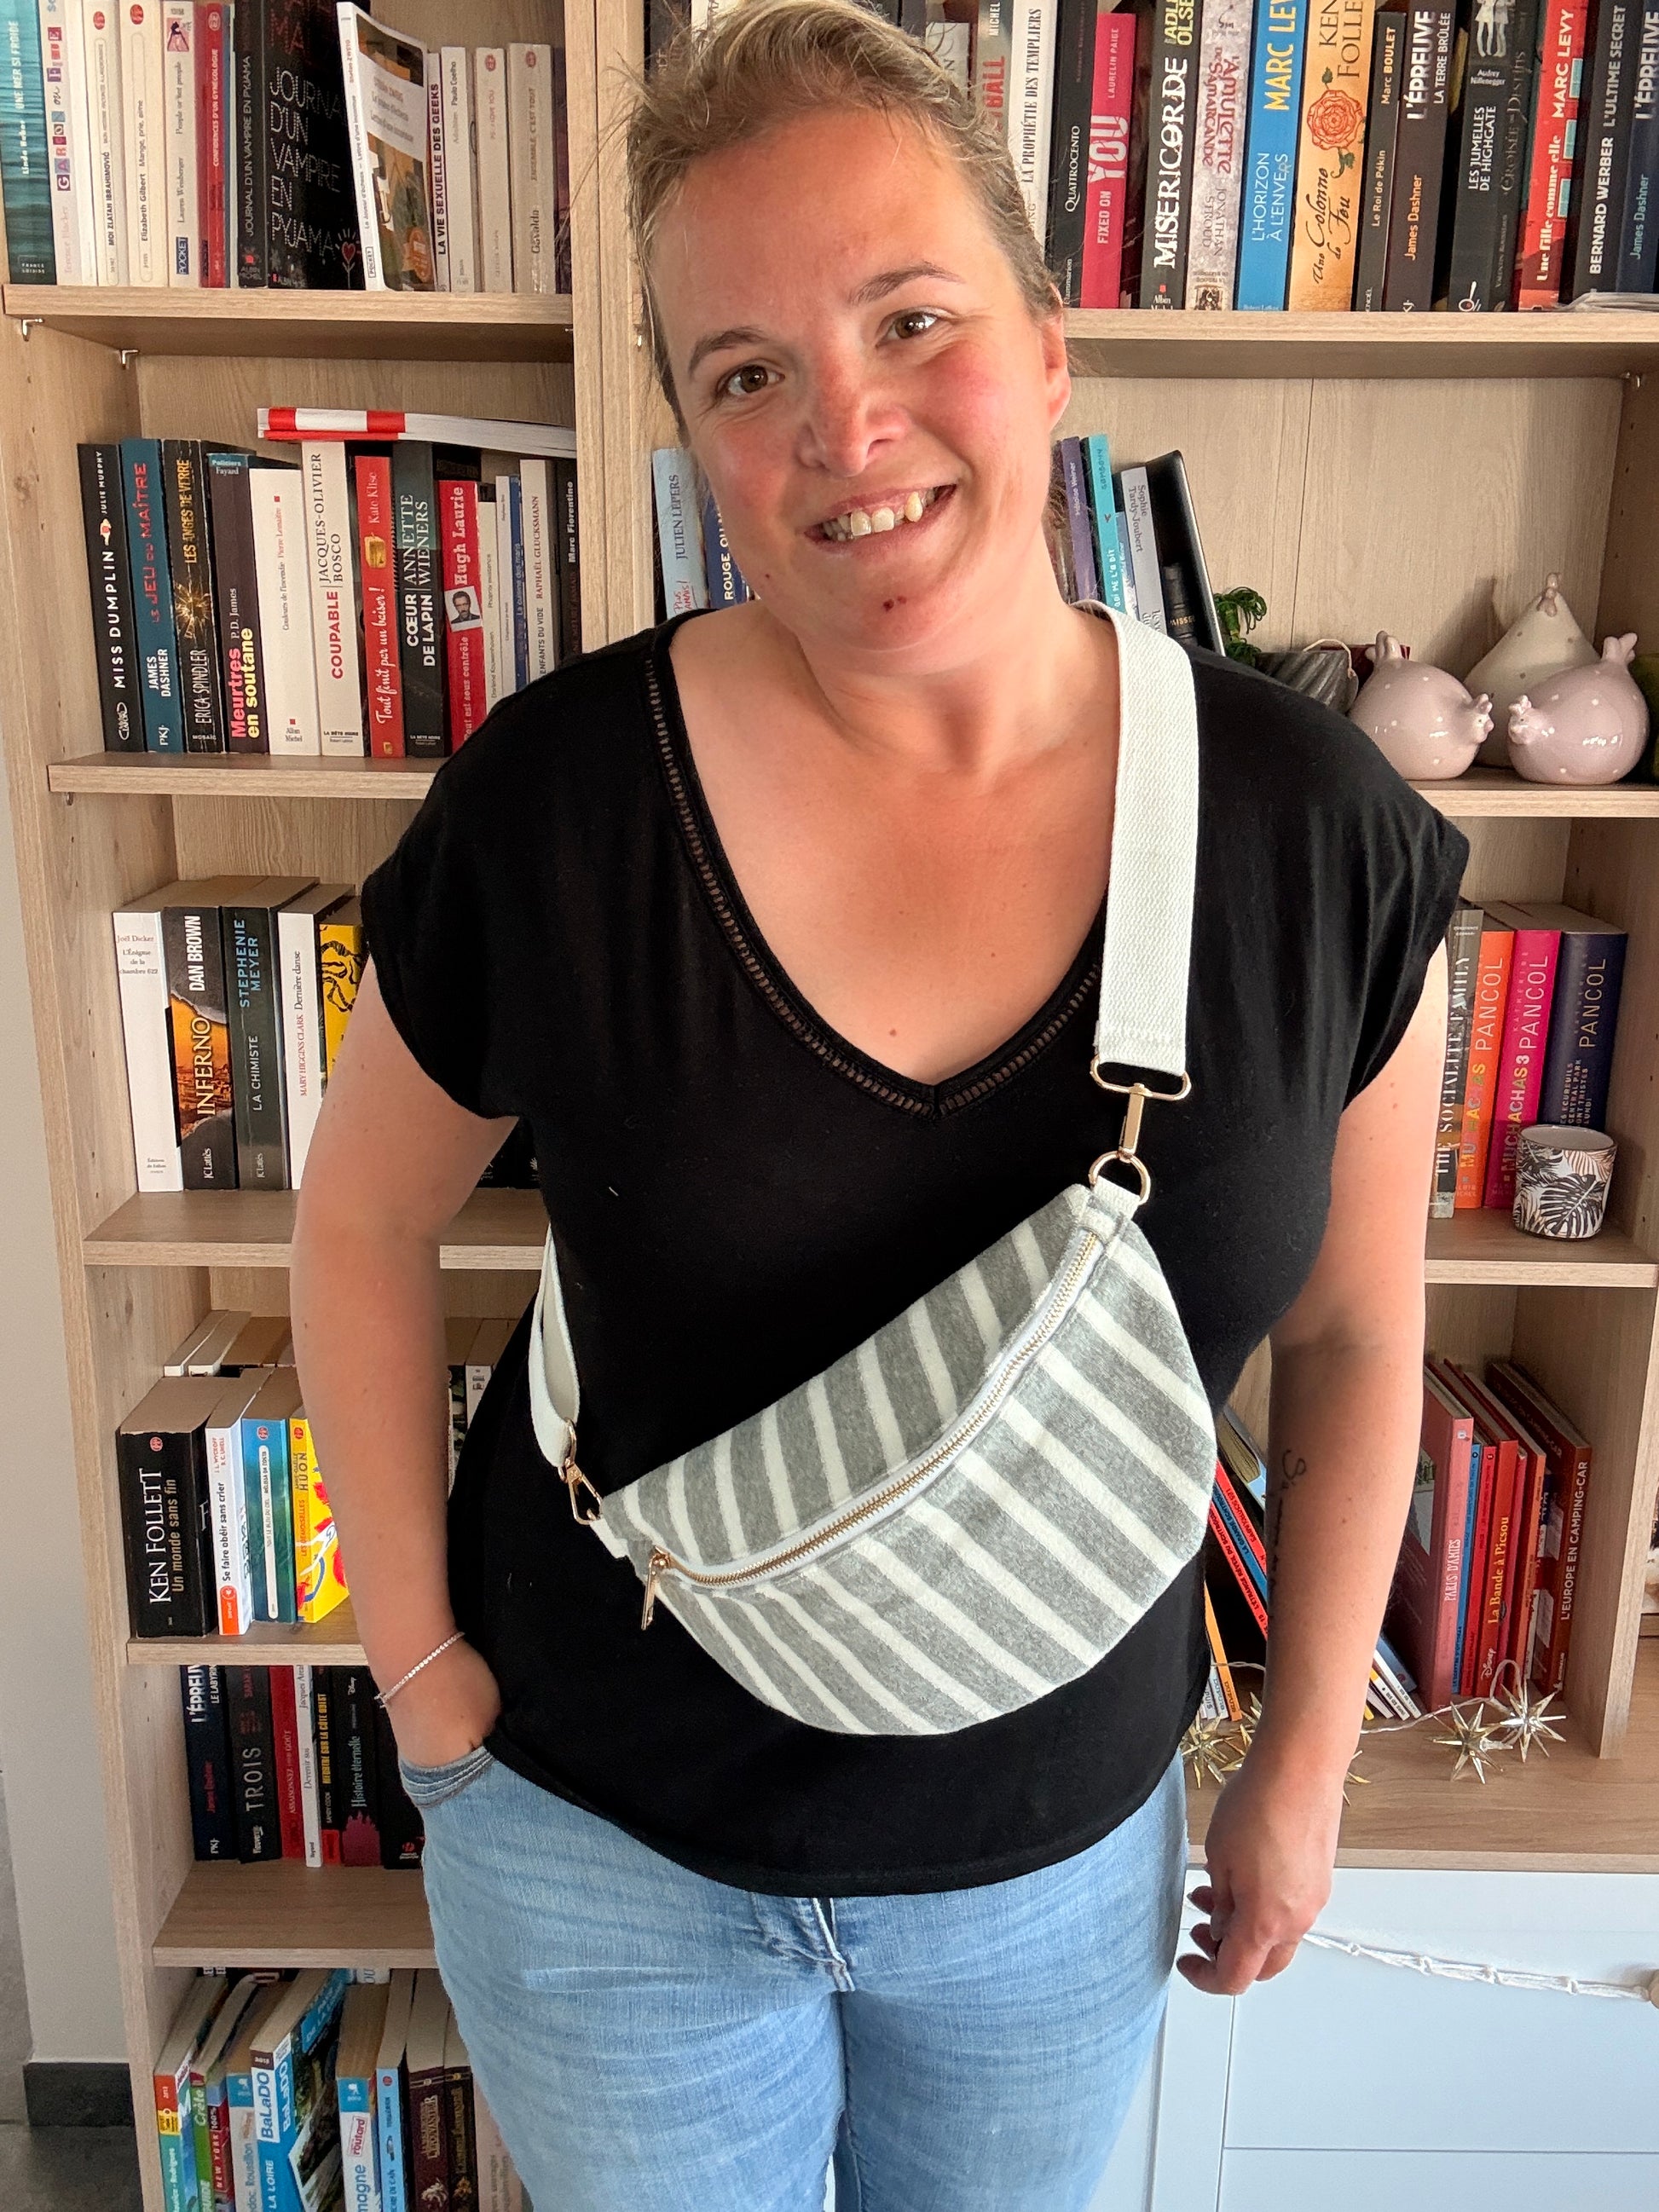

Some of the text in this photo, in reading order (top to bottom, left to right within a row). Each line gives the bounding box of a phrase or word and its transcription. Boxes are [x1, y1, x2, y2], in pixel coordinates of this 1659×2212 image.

[988, 2, 1001, 37] MICHEL
[1319, 0, 1340, 48] KEN
[242, 56, 251, 99] PYJAMA
[1107, 28, 1120, 99] LAURELIN PAIGE
[1407, 11, 1438, 120] L'ÉPREUVE
[1433, 12, 1451, 104] LA TERRE BRÛLÉE
[243, 100, 251, 114] EN
[1022, 9, 1042, 183] LA PROPHÉTIE DES TEMPLIERS
[1371, 27, 1396, 227] Le Roi de Pékin Marc BOULET
[244, 116, 253, 159] VAMPIRE
[1153, 57, 1188, 269] MISERICORDE
[1468, 107, 1486, 191] LES JUMELLES
[1479, 106, 1497, 192] DE HIGHGATE
[1536, 9, 1575, 282] Une fille comme elle MARC LEVY
[1589, 5, 1627, 274] BERNARD WERBER L'ULTIME SECRET
[1629, 11, 1659, 260] James Dashner L'ÉPREUVE
[103, 152, 113, 203] IBRAHIMOVIĆ
[245, 161, 253, 186] D'UN
[431, 84, 447, 255] LA VIE SEXUELLE DES GEEKS
[1064, 125, 1081, 213] QUATTROCENTO
[1088, 115, 1129, 245] FIXED ON YOU
[1251, 152, 1270, 242] L'HORIZON
[107, 205, 115, 232] ZLATAN
[246, 188, 254, 237] JOURNAL
[1202, 196, 1216, 248] STROUD
[1214, 188, 1228, 257] JONATHAN
[1403, 174, 1423, 261] James Dashner
[95, 451, 107, 488] MURPHY
[98, 489, 107, 515] JULIE
[176, 459, 192, 493] VERRE
[215, 466, 240, 477] Fayard
[367, 472, 380, 525] Kate Klise
[1137, 485, 1147, 517] Sophie
[310, 453, 330, 584] JACQUES-OLIVIER
[565, 481, 575, 534] Fiorentino
[668, 474, 688, 560] JULIEN LEPERS
[1128, 486, 1143, 552] Tardy-Joubert
[183, 544, 198, 563] LES
[332, 533, 344, 585] BOSCO
[399, 494, 419, 647] CŒUR ANNETTE
[567, 537, 576, 563] Marc
[721, 552, 734, 600] ROUGE
[102, 551, 123, 638] DUMPLIN
[371, 594, 388, 627] baiser
[414, 500, 436, 668] DE LAPIN WIENERS
[532, 496, 546, 674] ENFANTS DU VIDE RAPHAËL GLUCKSMANN
[112, 645, 126, 689] MISS
[326, 591, 344, 680] COUPABLE
[379, 628, 389, 645] un
[379, 647, 396, 667] par
[147, 656, 159, 690] JAMES
[158, 649, 172, 697] DASHNER
[189, 649, 210, 694] SPINDLER
[228, 648, 246, 739] Meurtres
[240, 627, 261, 739] en soutane
[374, 669, 397, 696] finit
[194, 695, 212, 725] ERICA
[375, 696, 393, 724] Tout
[184, 915, 205, 991] DAN BROWN
[233, 919, 251, 1008] STEPHENIE
[249, 936, 263, 992] MEYER
[1449, 956, 1471, 1021] FAMILY
[1518, 955, 1548, 1049] PANCOL
[1578, 958, 1607, 1048] PANCOL
[292, 950, 309, 1097] MARY HIGGINS CLARK Dernière danse
[191, 1016, 217, 1118] INFERNO
[249, 1034, 263, 1112] LA CHIMISTE
[1440, 1031, 1463, 1134] SOCIALITE
[1572, 1060, 1582, 1083] PARK
[1436, 1142, 1452, 1175] THE
[298, 1453, 309, 1491] HUON
[139, 1467, 172, 1604] KEN FOLLETT
[164, 1478, 184, 1592] Un monde sans fin
[217, 1481, 231, 1582] Se faire obéir sans crier
[1559, 1460, 1588, 1620] L'EUROPE EN CAMPING-CAR
[1444, 1539, 1461, 1602] PARIS D'AMIES
[1487, 1516, 1510, 1625] La Bande à Picsou
[347, 1676, 368, 1807] Histoire éternelle Disney
[242, 1747, 265, 1812] TROIS
[256, 2070, 274, 2139] BaLaDO
[352, 2117, 366, 2156] routard
[212, 2133, 224, 2188] NEW YORK
[243, 2142, 255, 2186] Roussillon
[265, 2159, 278, 2209] LA LOIRE
